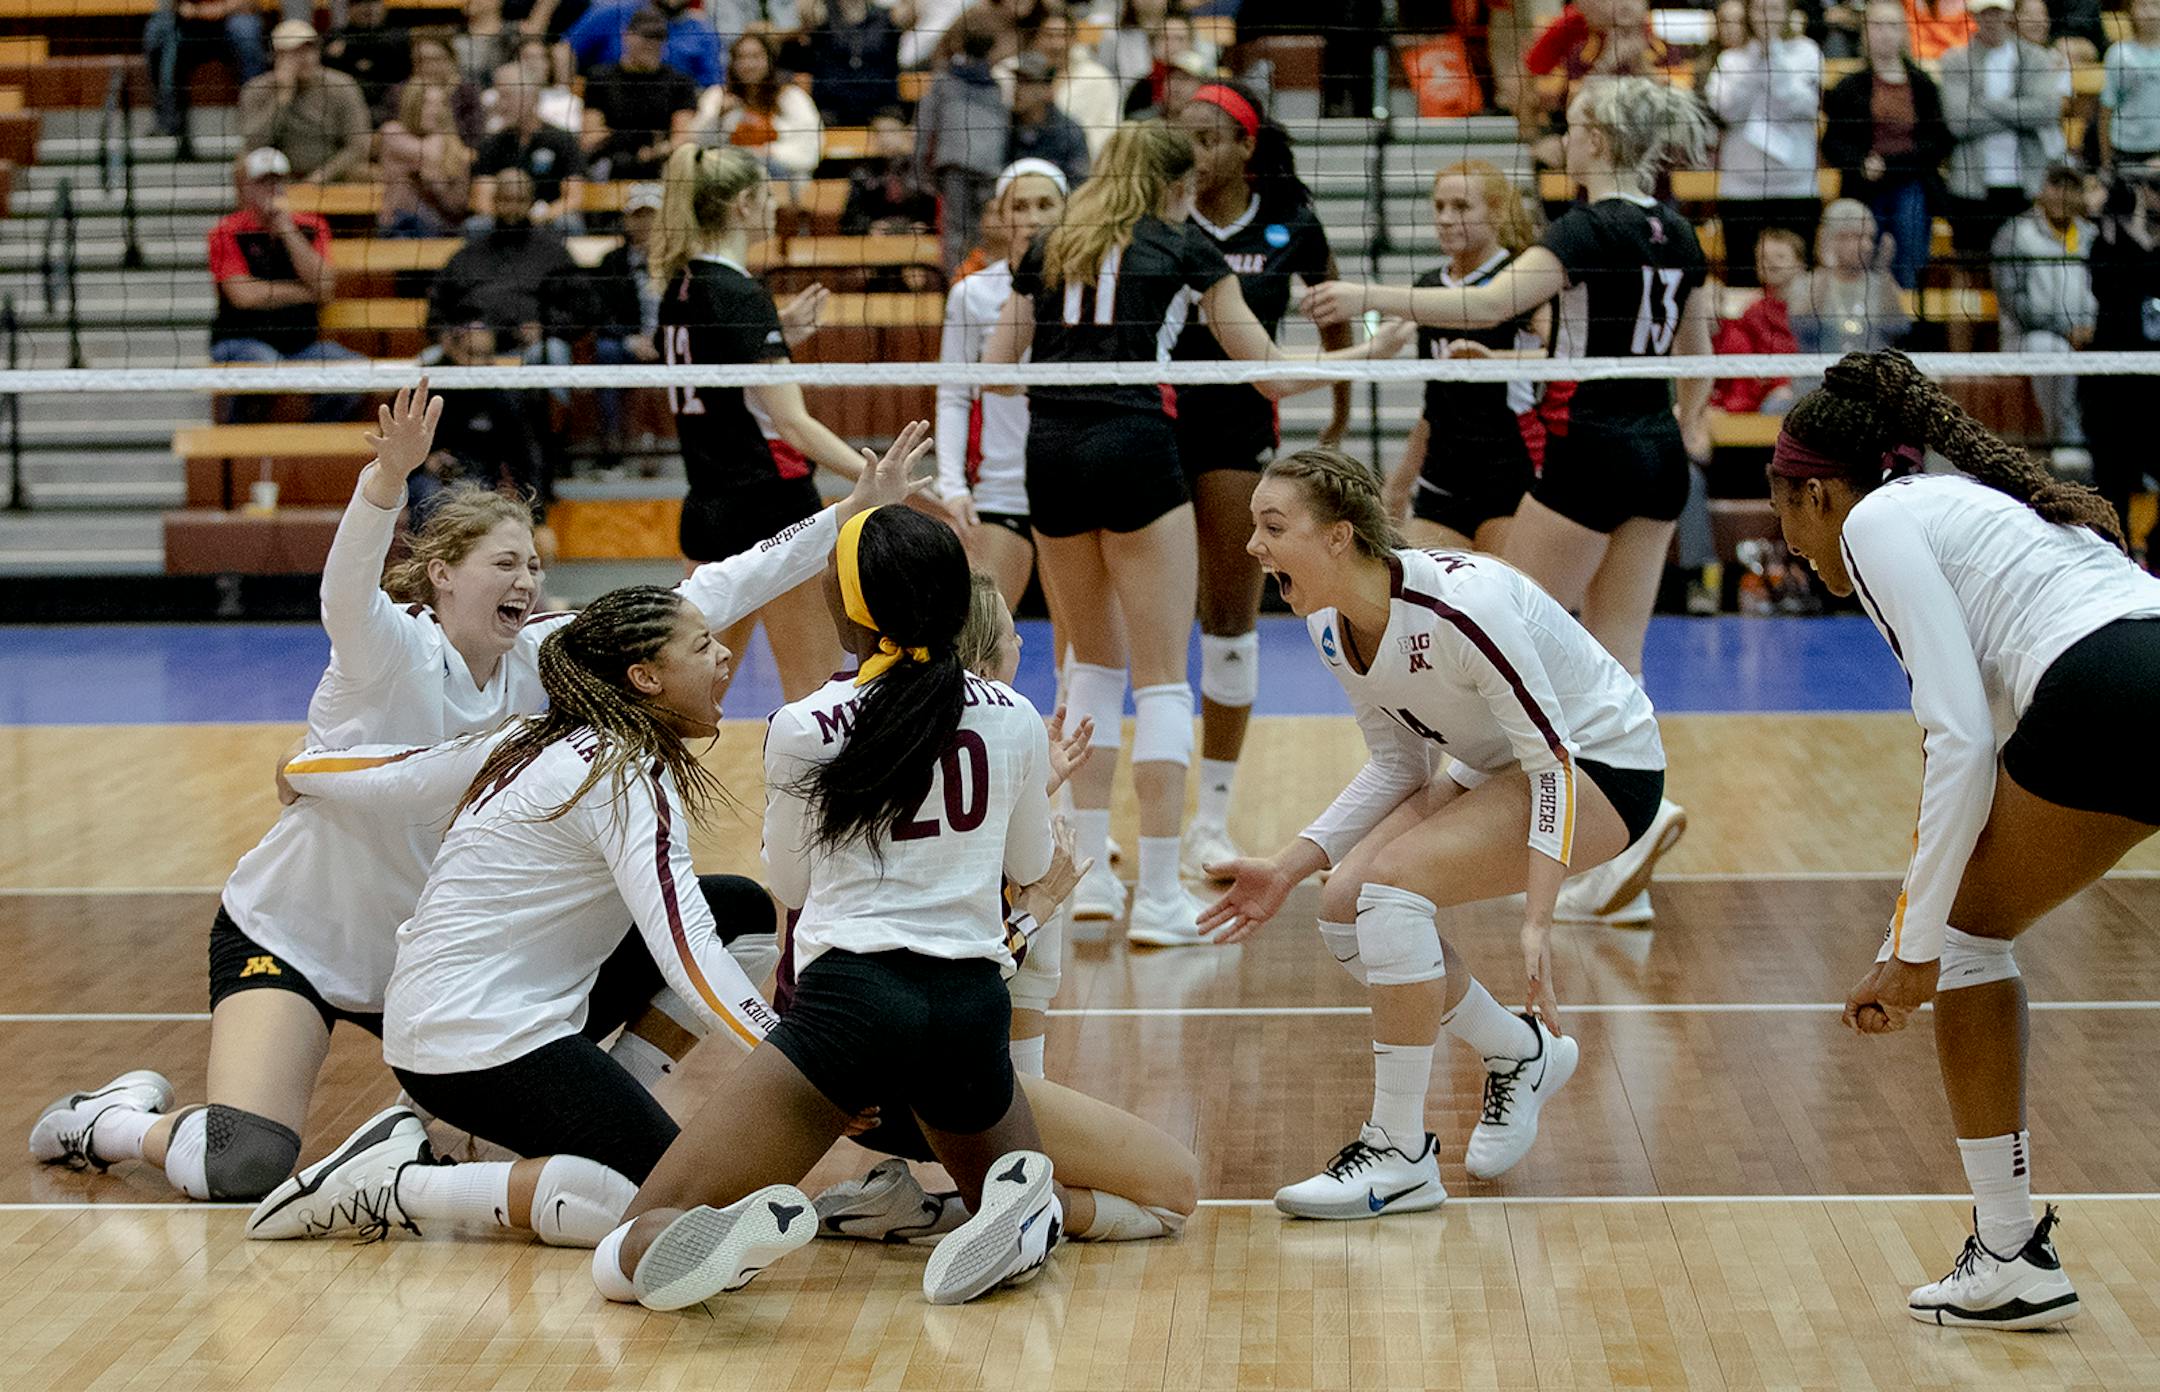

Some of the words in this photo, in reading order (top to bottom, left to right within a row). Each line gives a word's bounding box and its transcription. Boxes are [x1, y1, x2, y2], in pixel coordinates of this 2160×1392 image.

[1631, 265, 1684, 356] 13
[664, 325, 706, 415] 12
[760, 517, 816, 553] GOPHERS
[1378, 705, 1449, 745] 14
[891, 729, 989, 842] 20
[1538, 771, 1557, 834] GOPHERS
[239, 955, 281, 978] M
